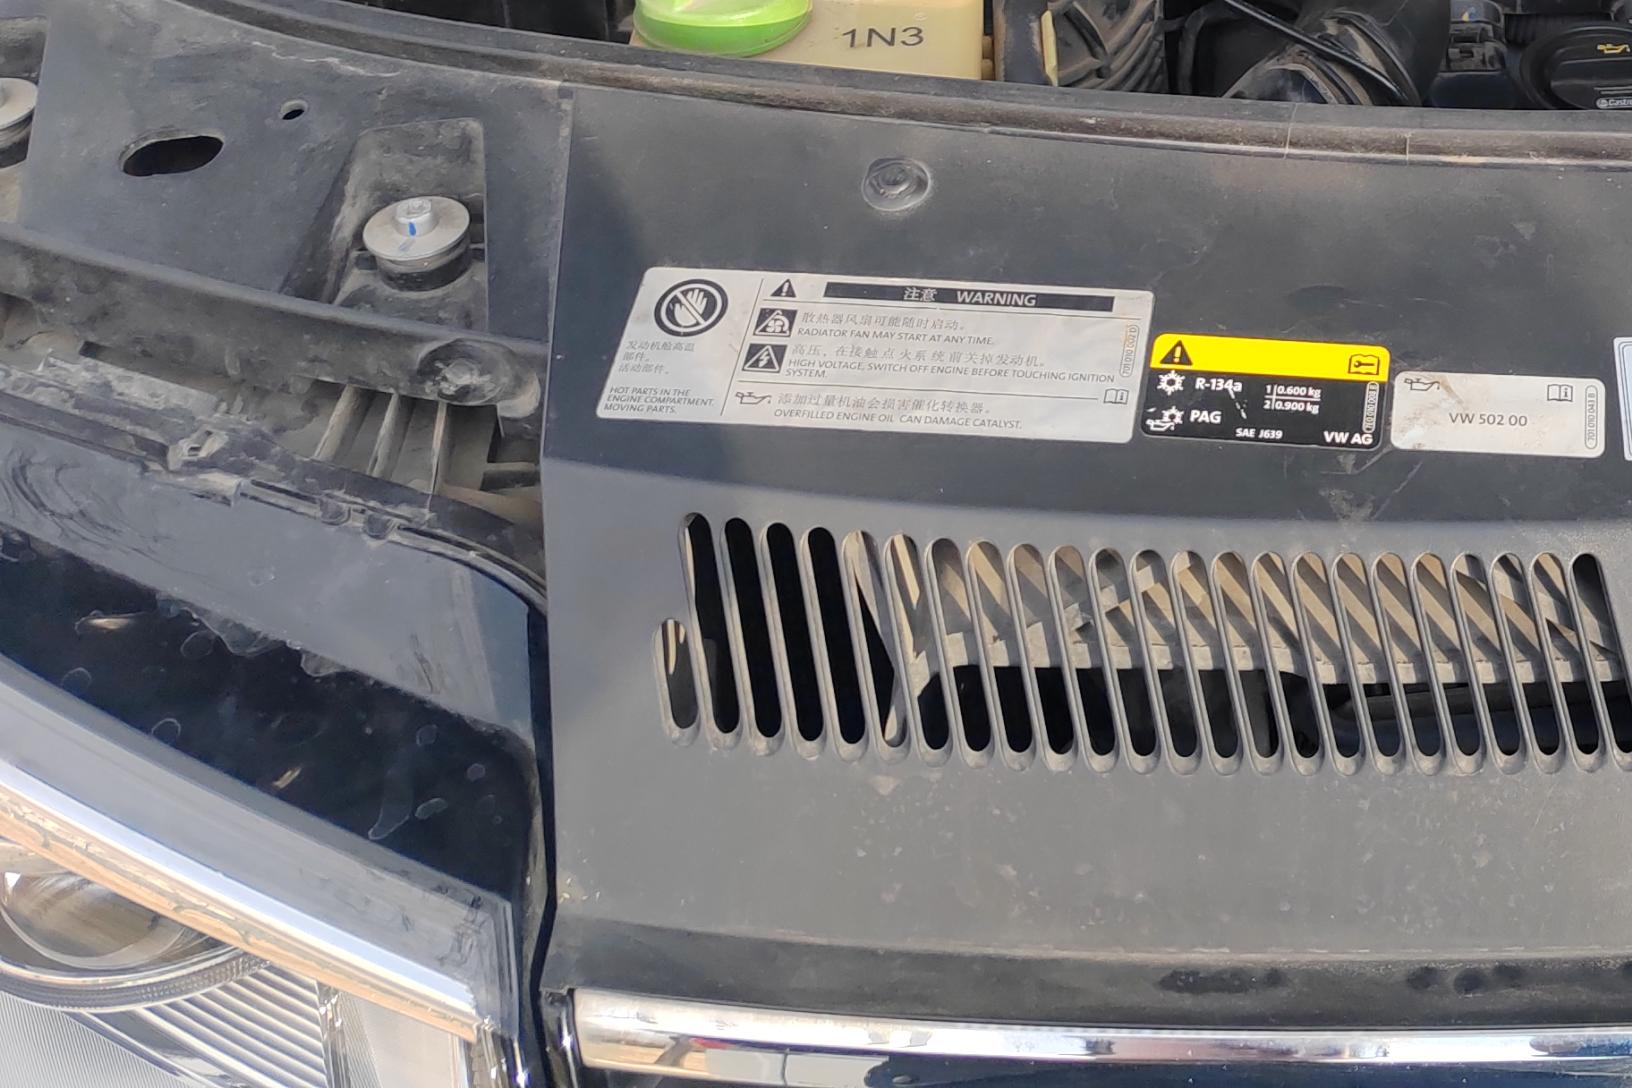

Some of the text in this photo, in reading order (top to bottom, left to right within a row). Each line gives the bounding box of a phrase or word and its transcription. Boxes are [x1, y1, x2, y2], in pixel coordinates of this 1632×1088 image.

[842, 26, 924, 48] 1N3
[904, 287, 1037, 307] 注意 WARNING
[798, 328, 847, 338] RADIATOR
[849, 330, 869, 339] FAN
[873, 331, 896, 340] MAY
[899, 332, 927, 342] START
[929, 334, 942, 343] AT
[943, 335, 966, 344] ANY
[786, 369, 828, 379] SYSTEM.
[788, 359, 817, 368] HIGH
[867, 363, 907, 373] SWITCH
[909, 364, 929, 374] OFF
[930, 365, 969, 375] ENGINE
[971, 368, 1009, 377] BEFORE
[1012, 370, 1066, 381] TOUCHING
[1068, 373, 1115, 383] IGNITION
[1195, 377, 1242, 392] R-134a
[610, 386, 690, 397] HOT PARTS IN THE
[1277, 386, 1307, 396] 0.600
[1309, 387, 1321, 399] kg
[607, 394, 641, 403] ENGINE
[603, 403, 644, 412] MOVING
[1275, 401, 1305, 412] 0.900
[1306, 403, 1319, 414] kg
[774, 409, 834, 420] OVERFILLED
[836, 412, 875, 422] ENGINE
[878, 414, 895, 423] OIL
[900, 415, 922, 425] CAN
[924, 416, 970, 426] DAMAGE
[1190, 411, 1222, 424] PAG
[1449, 413, 1528, 427] VW 502 00
[1236, 428, 1283, 440] SAE J639
[1323, 431, 1373, 445] VW AG
